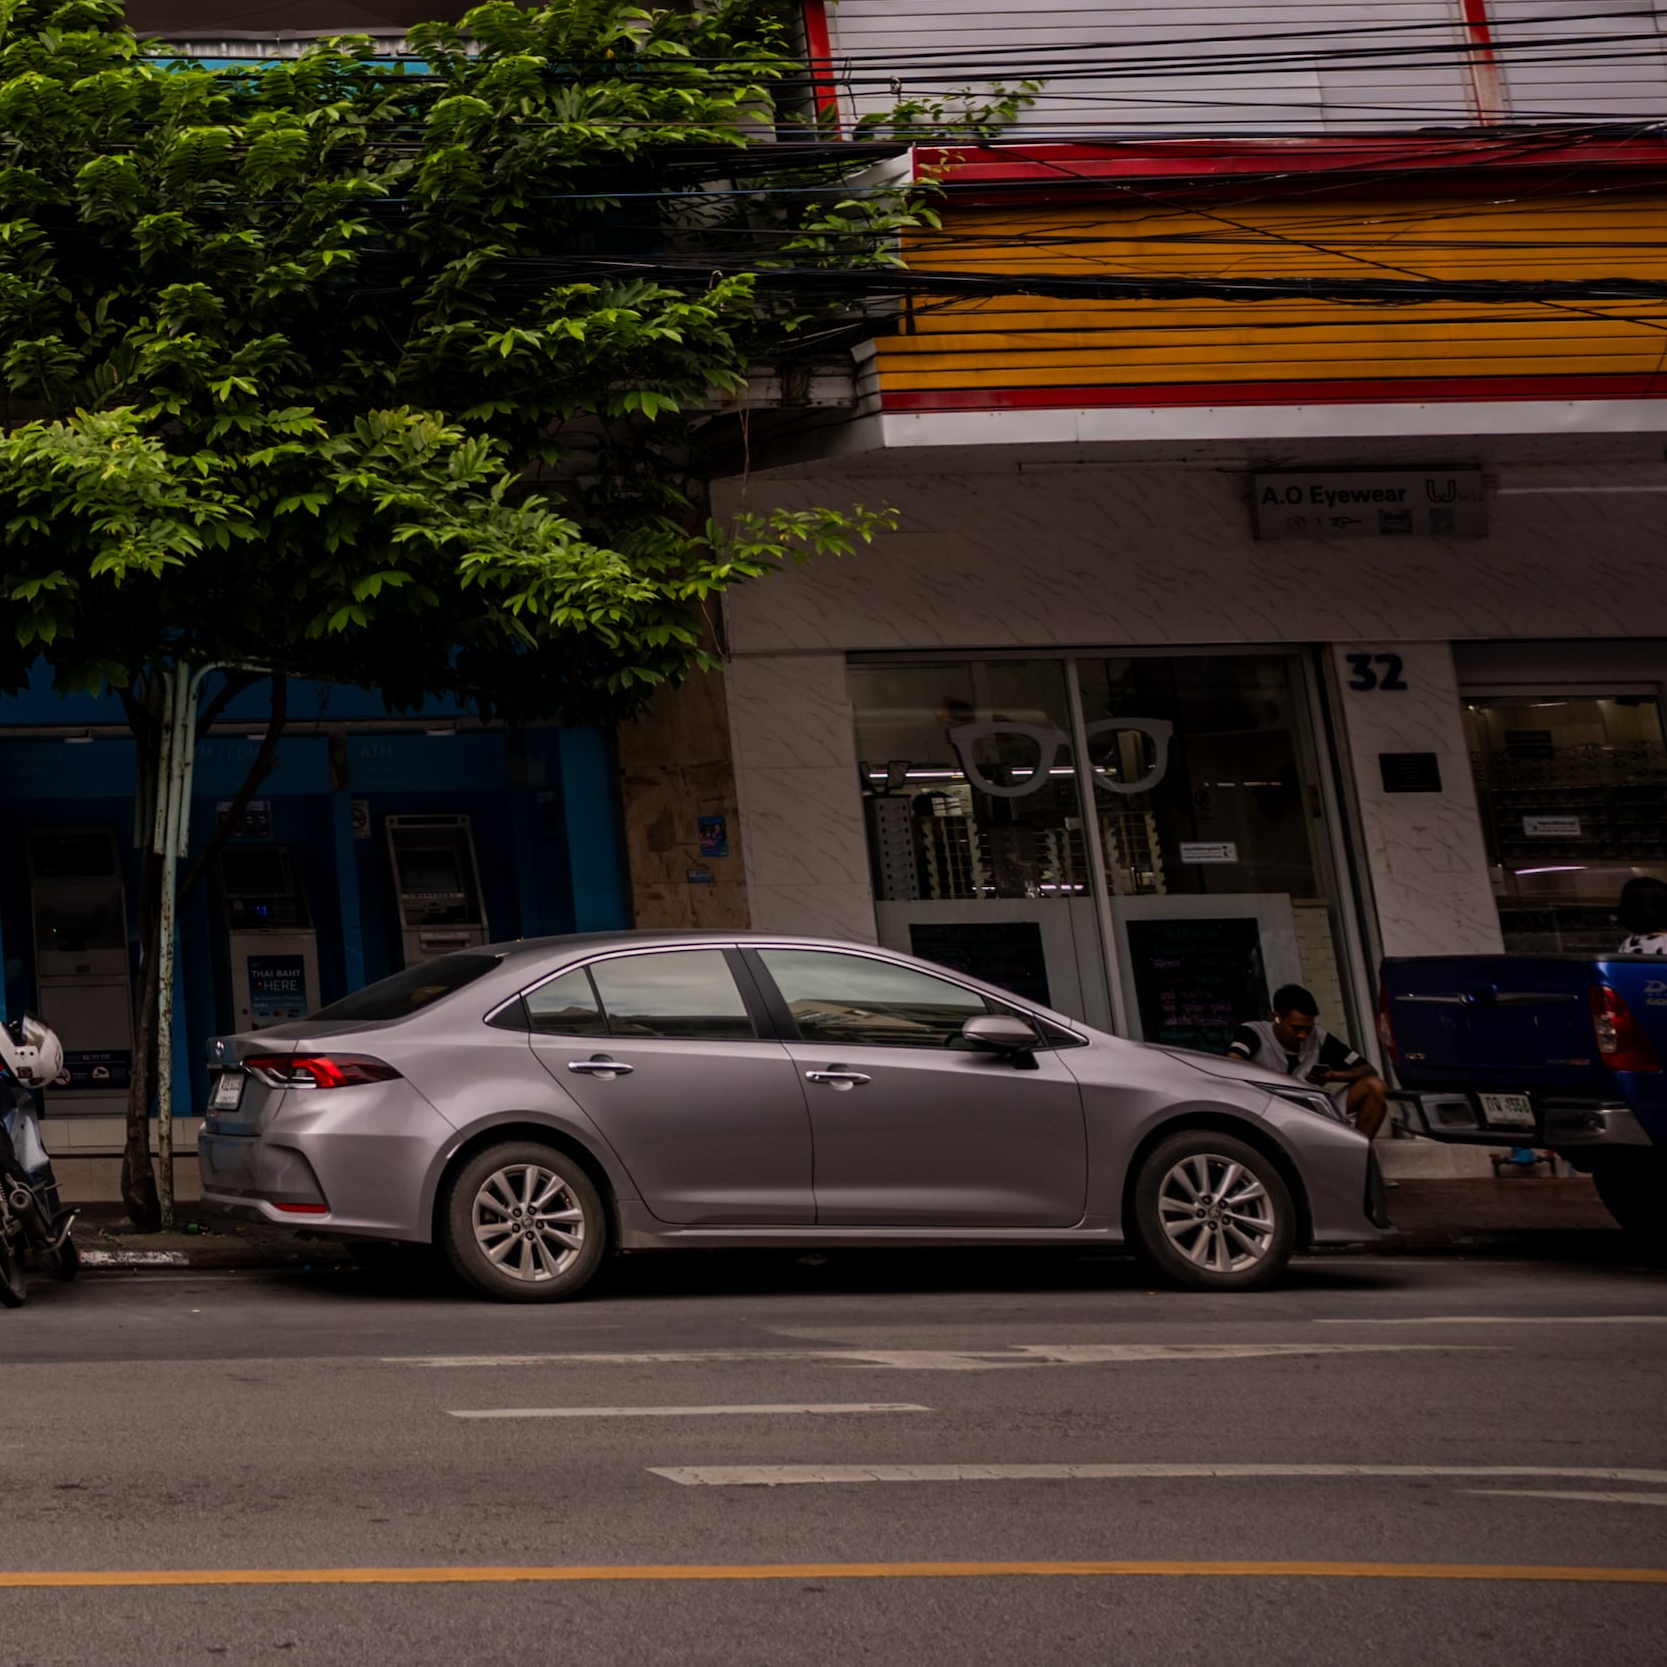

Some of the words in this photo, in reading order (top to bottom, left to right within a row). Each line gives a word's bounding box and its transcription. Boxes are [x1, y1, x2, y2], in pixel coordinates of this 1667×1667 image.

[1311, 485, 1407, 507] Eyewear
[1347, 654, 1407, 690] 32
[251, 969, 274, 978] THAI
[276, 969, 300, 977] BAHT
[264, 980, 299, 991] HERE
